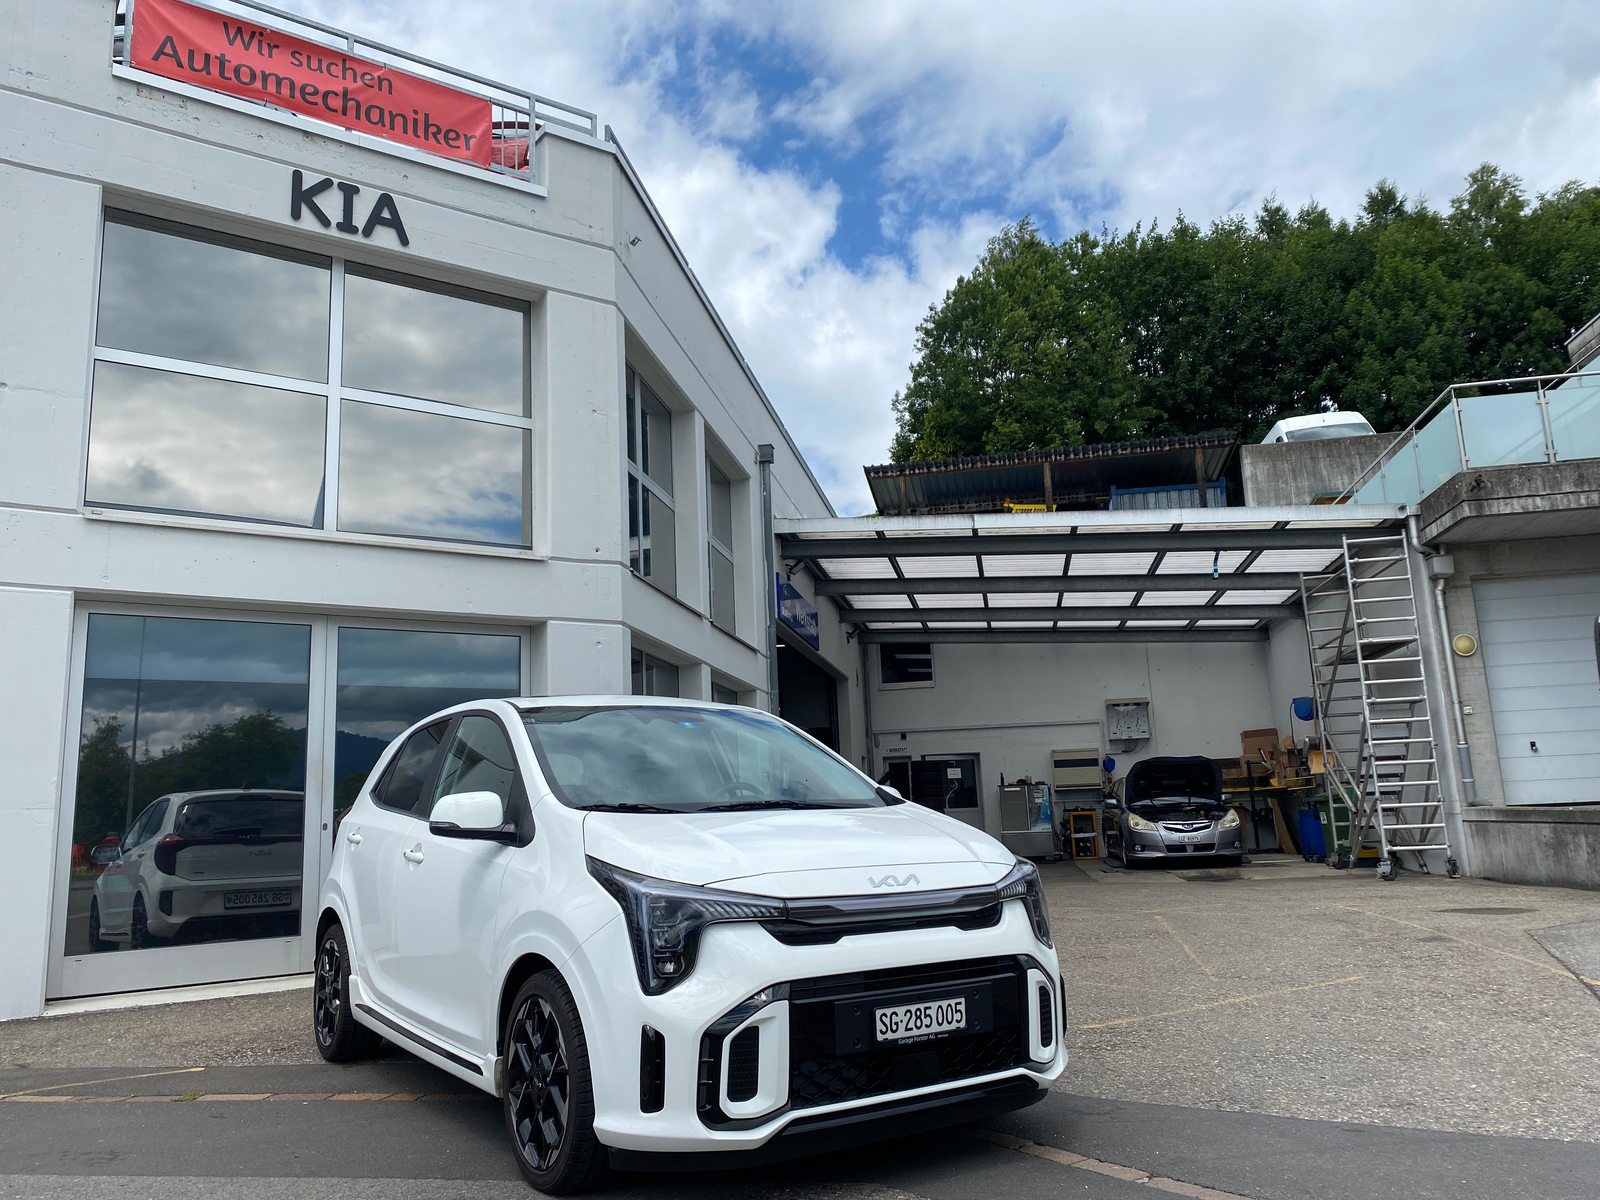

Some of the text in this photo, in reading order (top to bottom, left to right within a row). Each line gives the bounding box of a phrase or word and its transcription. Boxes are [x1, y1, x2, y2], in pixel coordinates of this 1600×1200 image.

[151, 35, 478, 151] Automechaniker
[222, 21, 394, 95] Wir suchen
[290, 168, 410, 247] KIA
[898, 1037, 914, 1045] Garage
